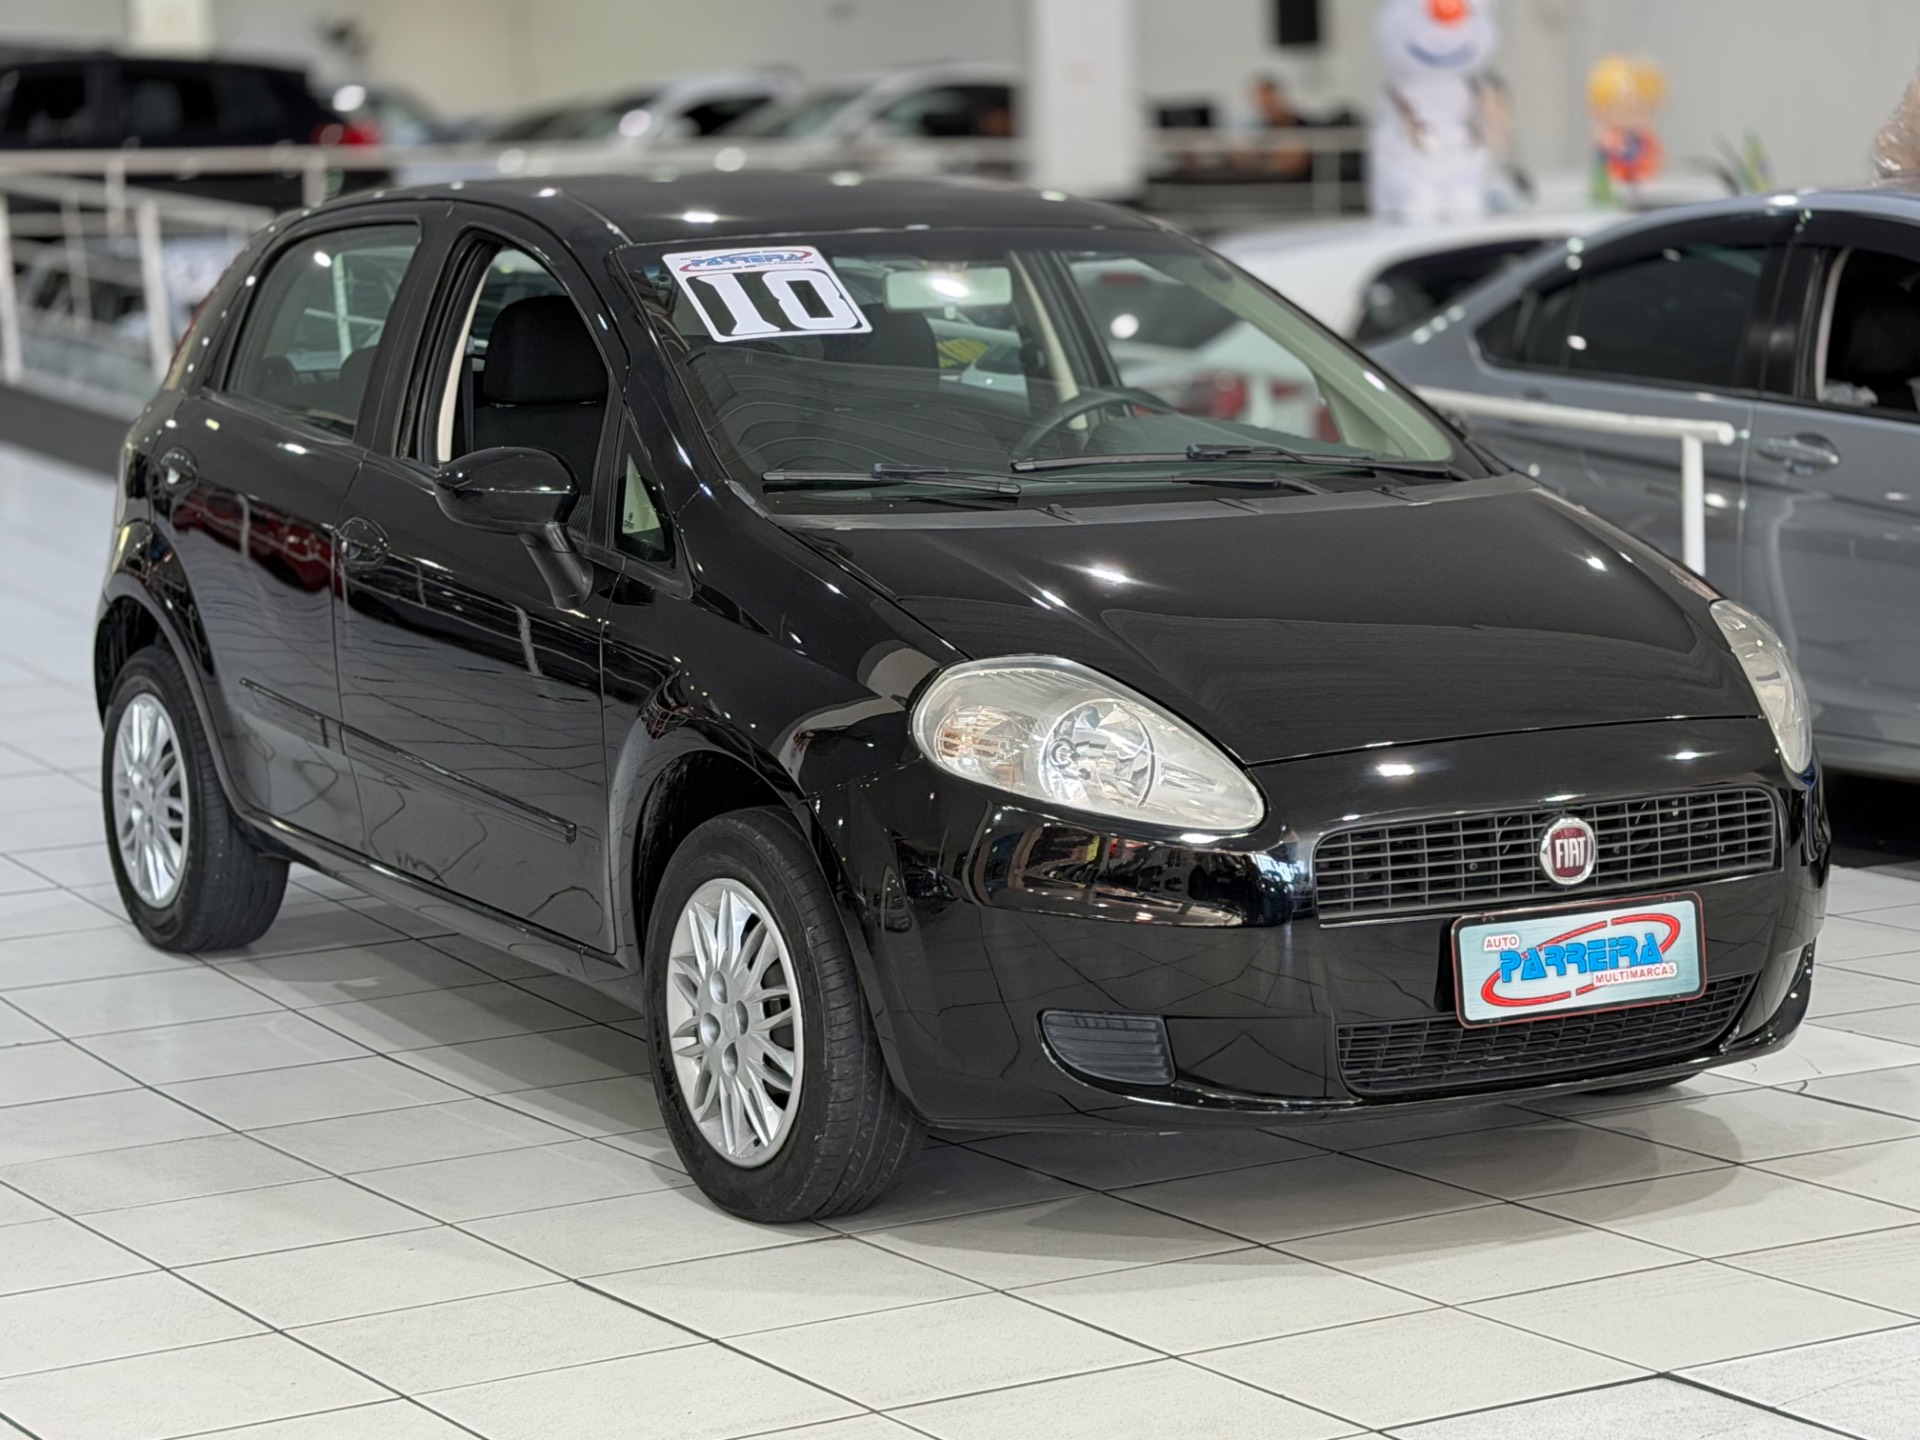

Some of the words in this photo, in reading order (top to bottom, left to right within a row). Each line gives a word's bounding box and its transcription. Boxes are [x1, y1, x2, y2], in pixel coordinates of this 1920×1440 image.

[696, 270, 857, 335] 10
[1555, 837, 1586, 869] FIAT
[1486, 937, 1517, 949] AUTO
[1501, 933, 1663, 983] PARREIRA
[1595, 966, 1675, 983] MULTIMARCAS
